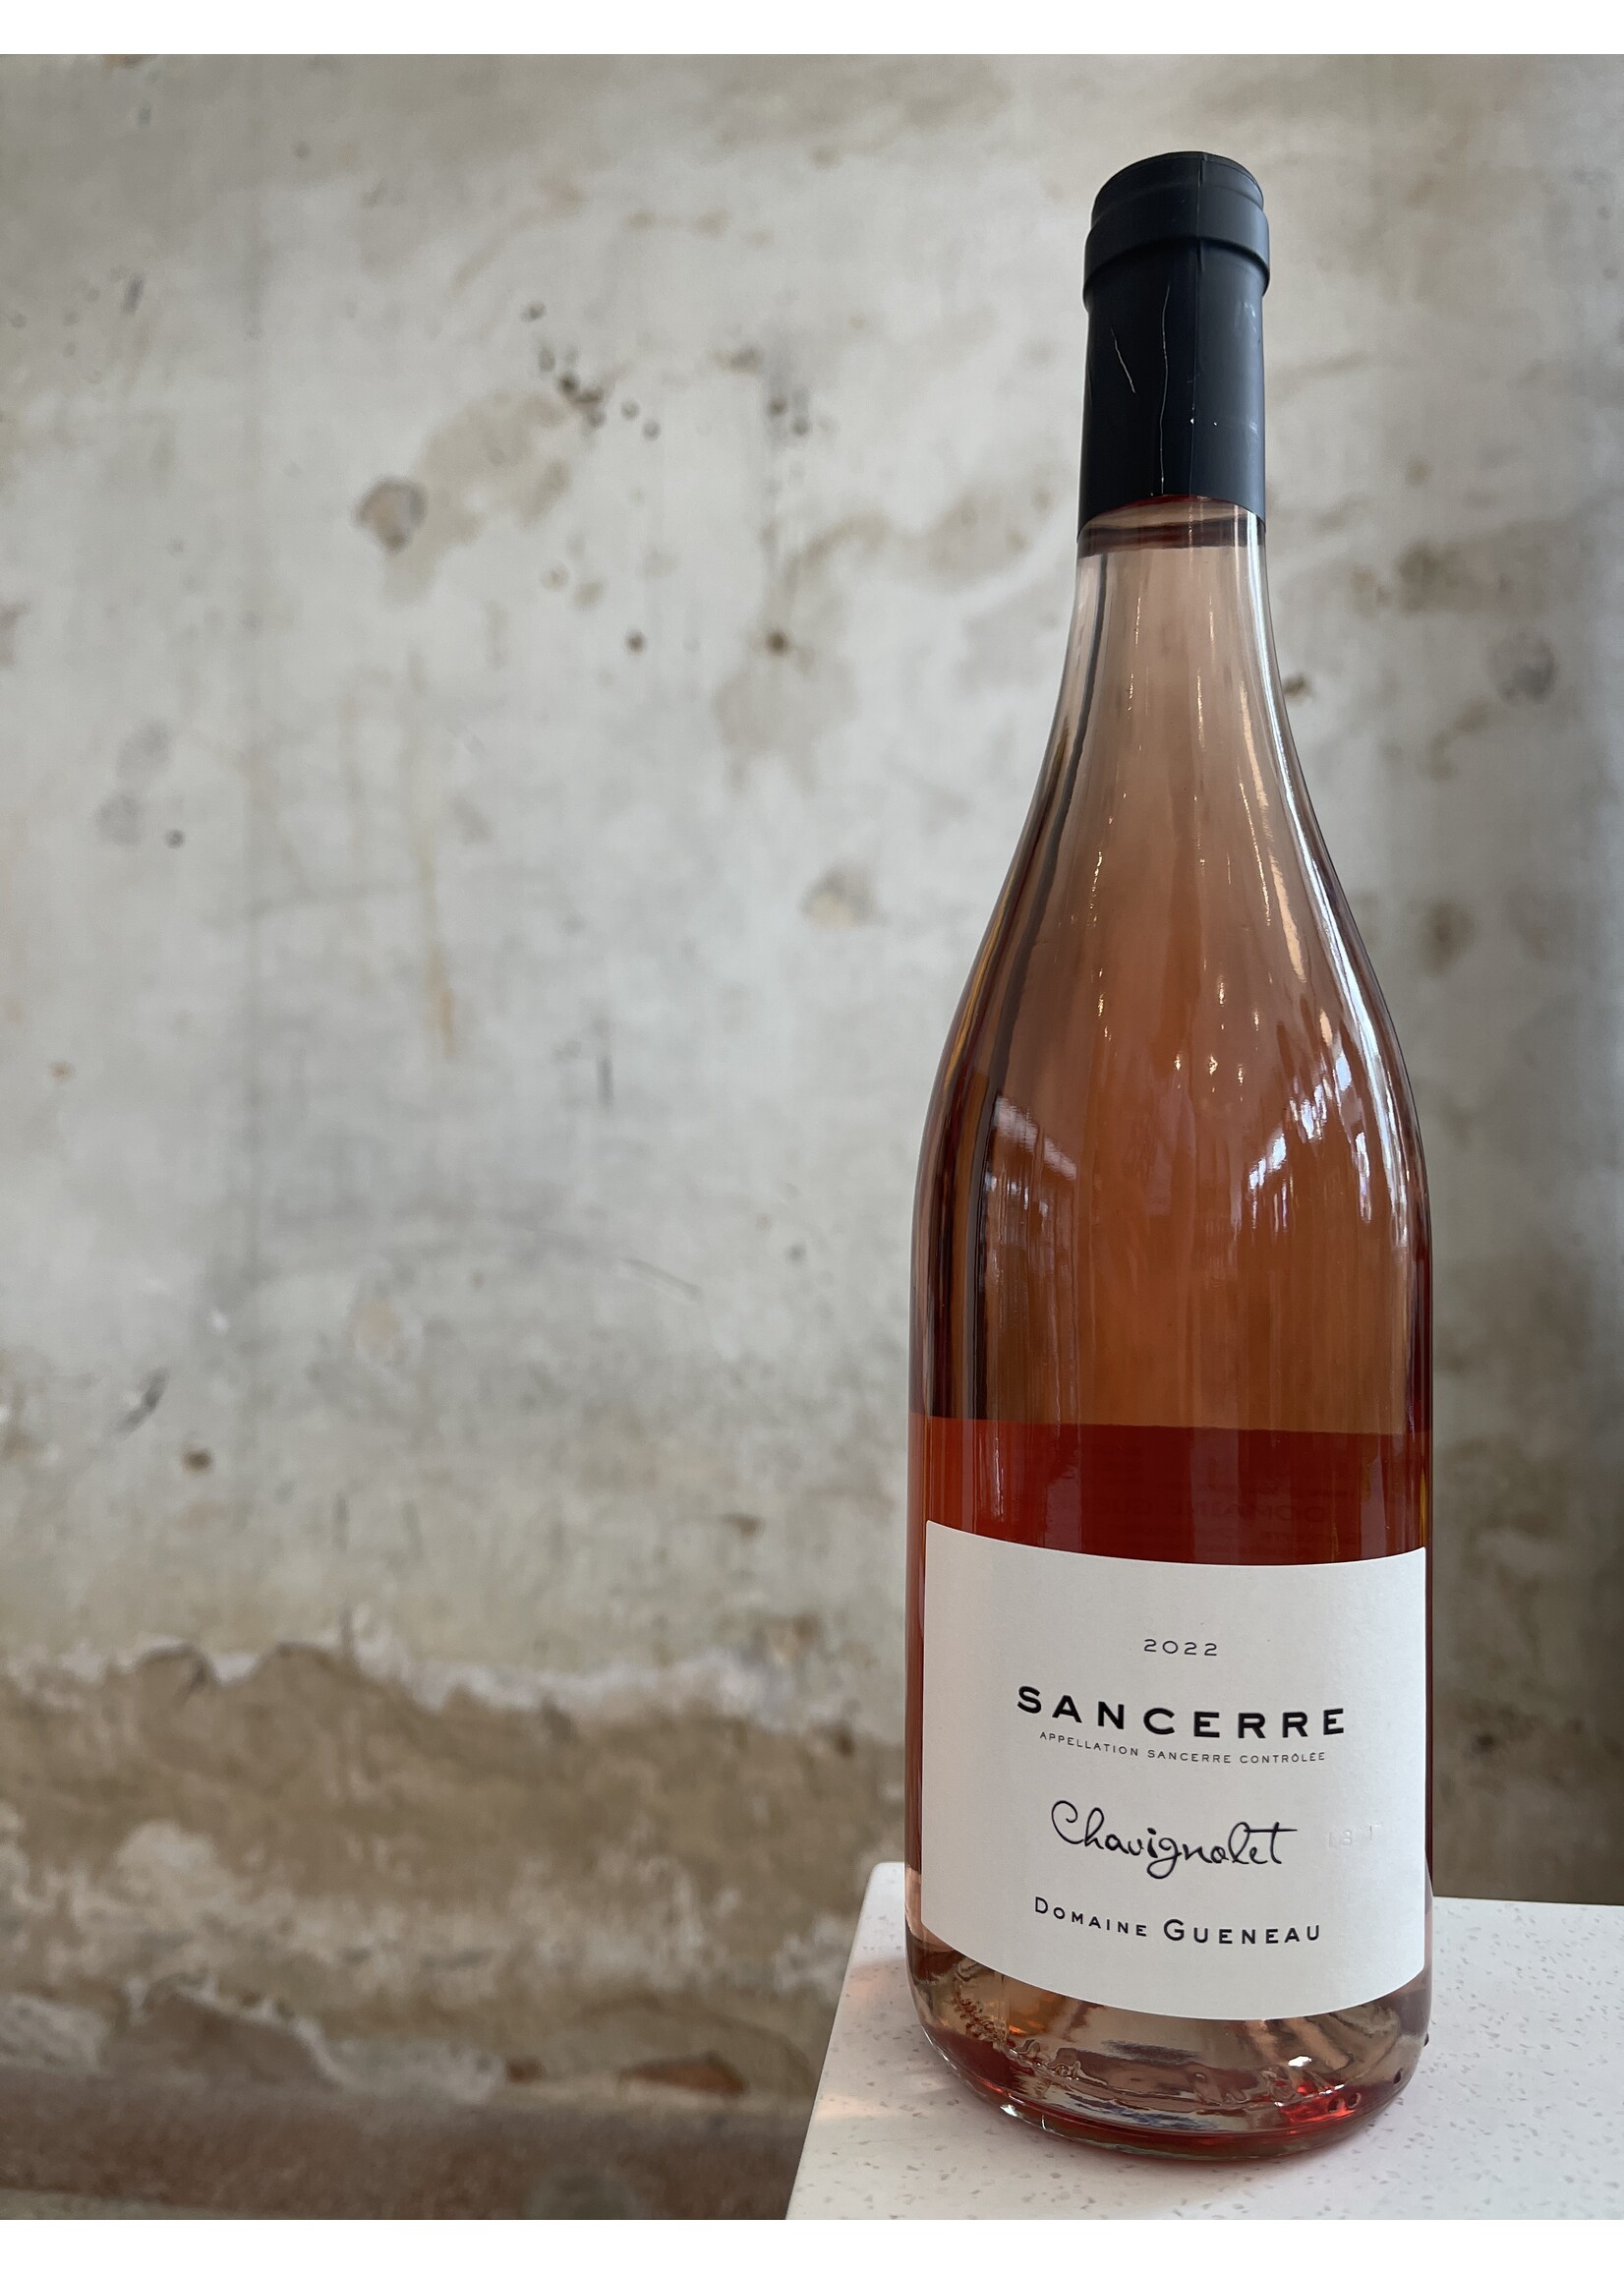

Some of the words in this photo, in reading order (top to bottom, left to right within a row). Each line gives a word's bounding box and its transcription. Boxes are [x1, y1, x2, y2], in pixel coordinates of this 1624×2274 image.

[1142, 1638, 1219, 1658] 2022
[1015, 1684, 1346, 1739] SANCERRE
[1038, 1730, 1139, 1758] APPELLATION
[1146, 1748, 1232, 1765] SANCERRE
[1239, 1750, 1326, 1765] CONTRÔLÉE
[1050, 1799, 1299, 1880] Chavignolet
[1033, 1895, 1148, 1939] DOMAINE
[1162, 1917, 1320, 1946] GUENEAU
